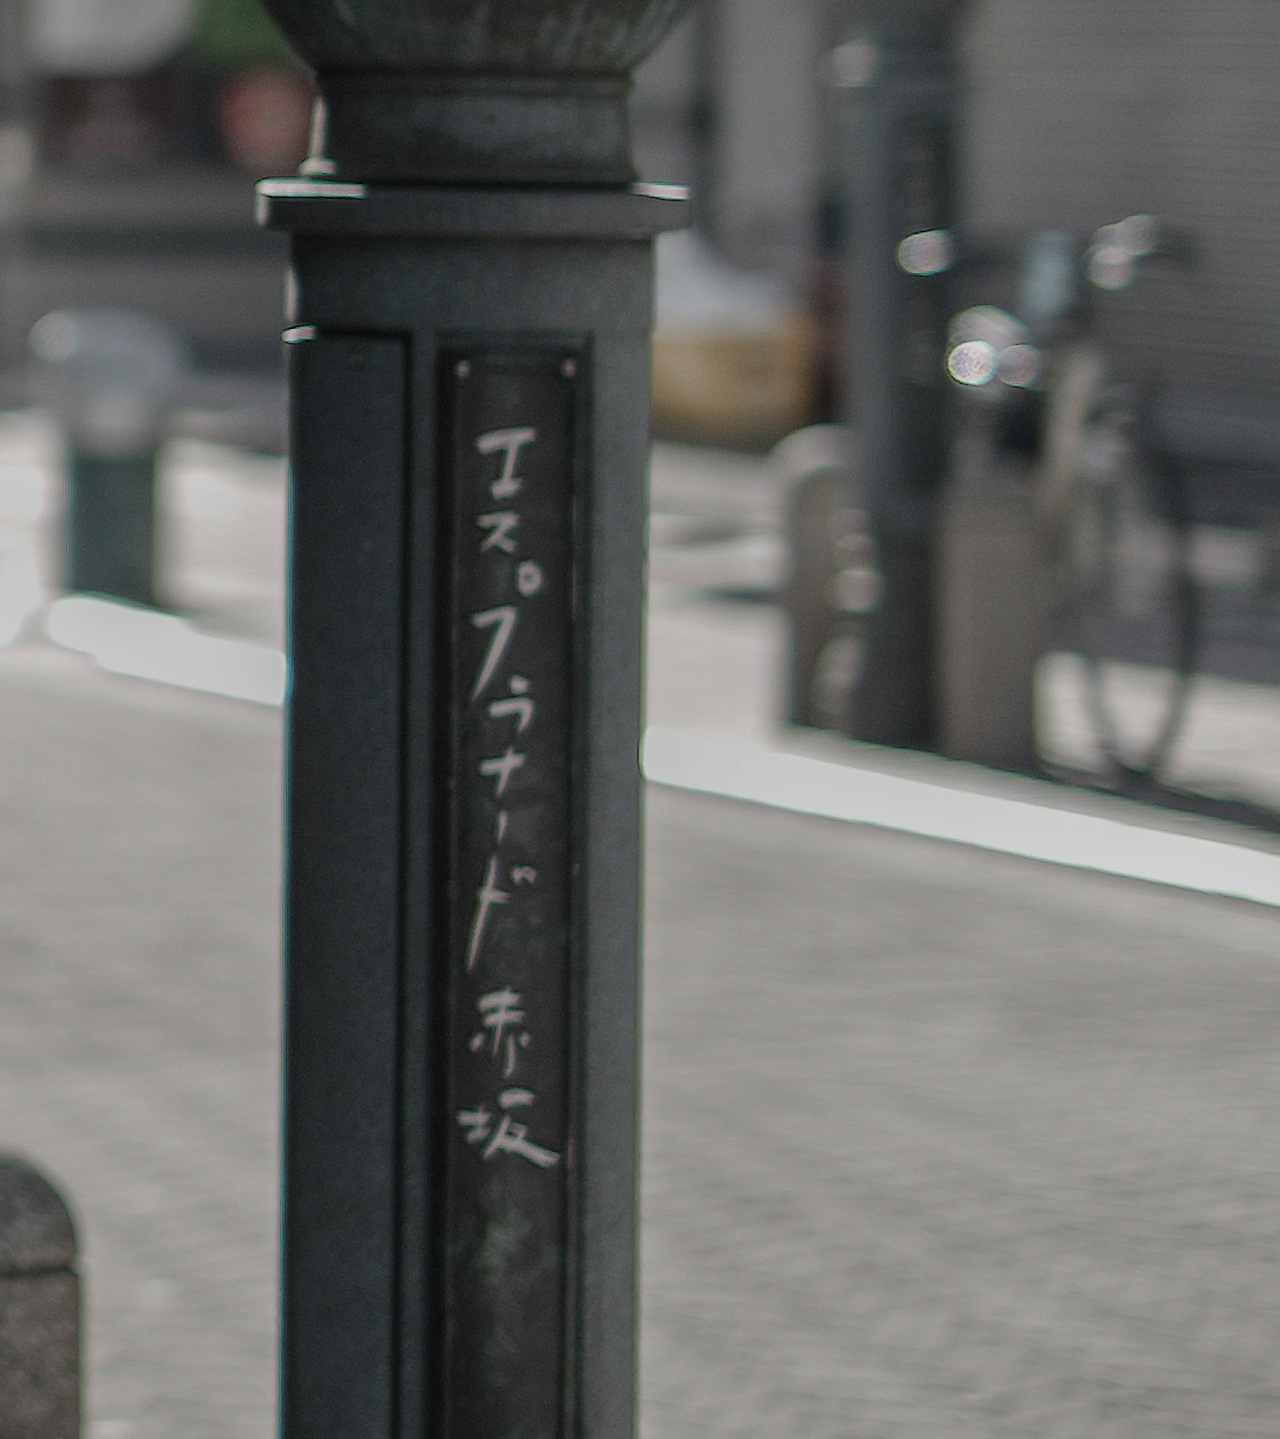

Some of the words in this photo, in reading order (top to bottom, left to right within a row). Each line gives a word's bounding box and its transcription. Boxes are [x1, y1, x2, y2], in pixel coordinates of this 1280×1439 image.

[455, 425, 561, 1169] エスプラナード赤坂
